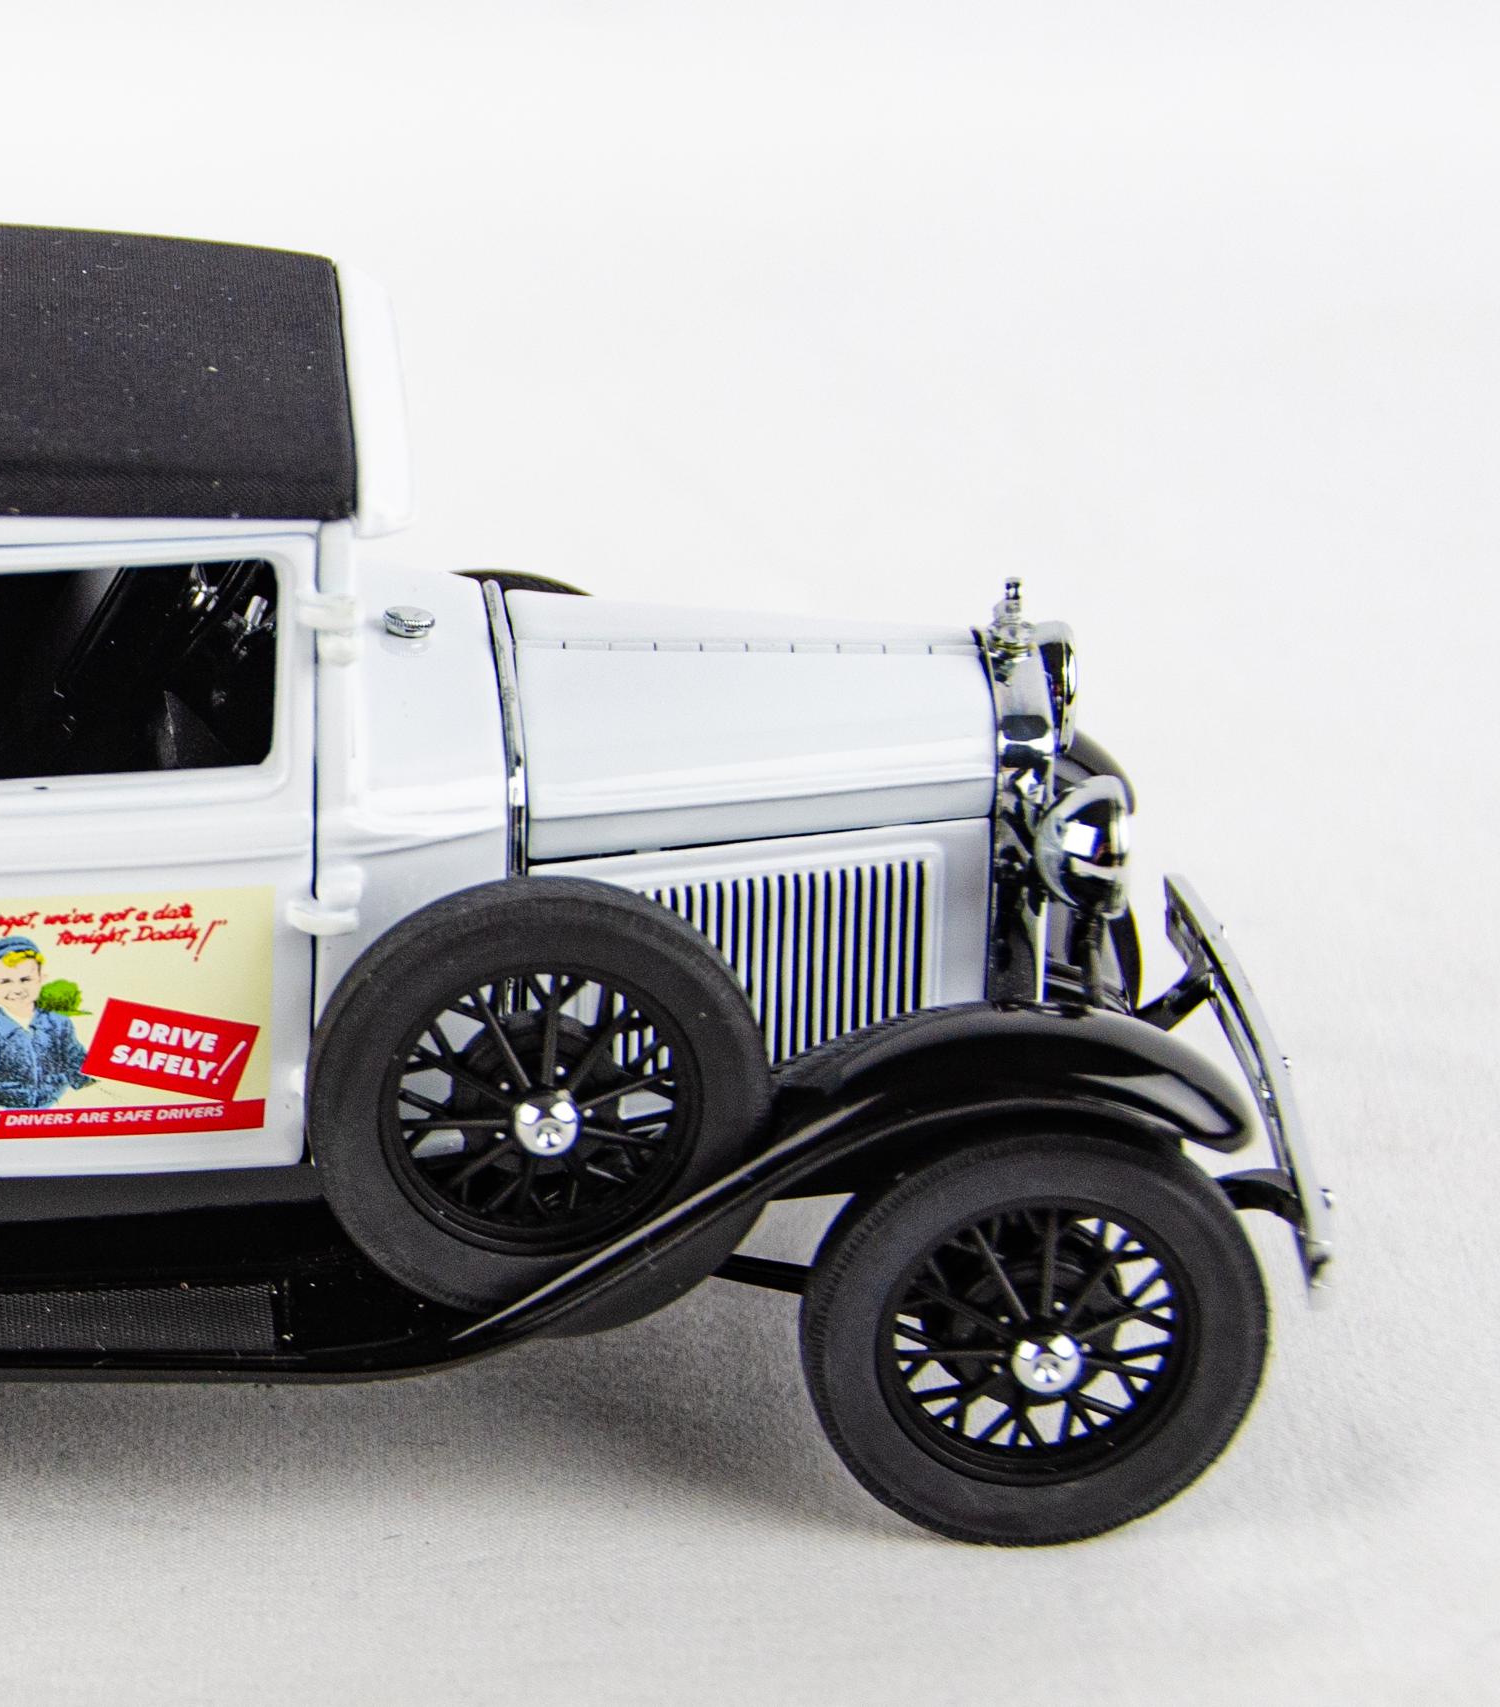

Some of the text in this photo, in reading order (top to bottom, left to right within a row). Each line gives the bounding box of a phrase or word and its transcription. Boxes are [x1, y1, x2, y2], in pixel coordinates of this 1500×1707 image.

[43, 908, 94, 925] we've
[100, 906, 136, 930] got
[135, 910, 149, 922] a
[152, 903, 192, 921] date
[127, 1018, 219, 1053] DRIVE
[110, 1040, 247, 1085] SAFELY!
[5, 1112, 73, 1127] DRIVERS
[76, 1111, 109, 1124] ARE
[113, 1109, 153, 1123] SAFE
[156, 1105, 224, 1121] DRIVERS
